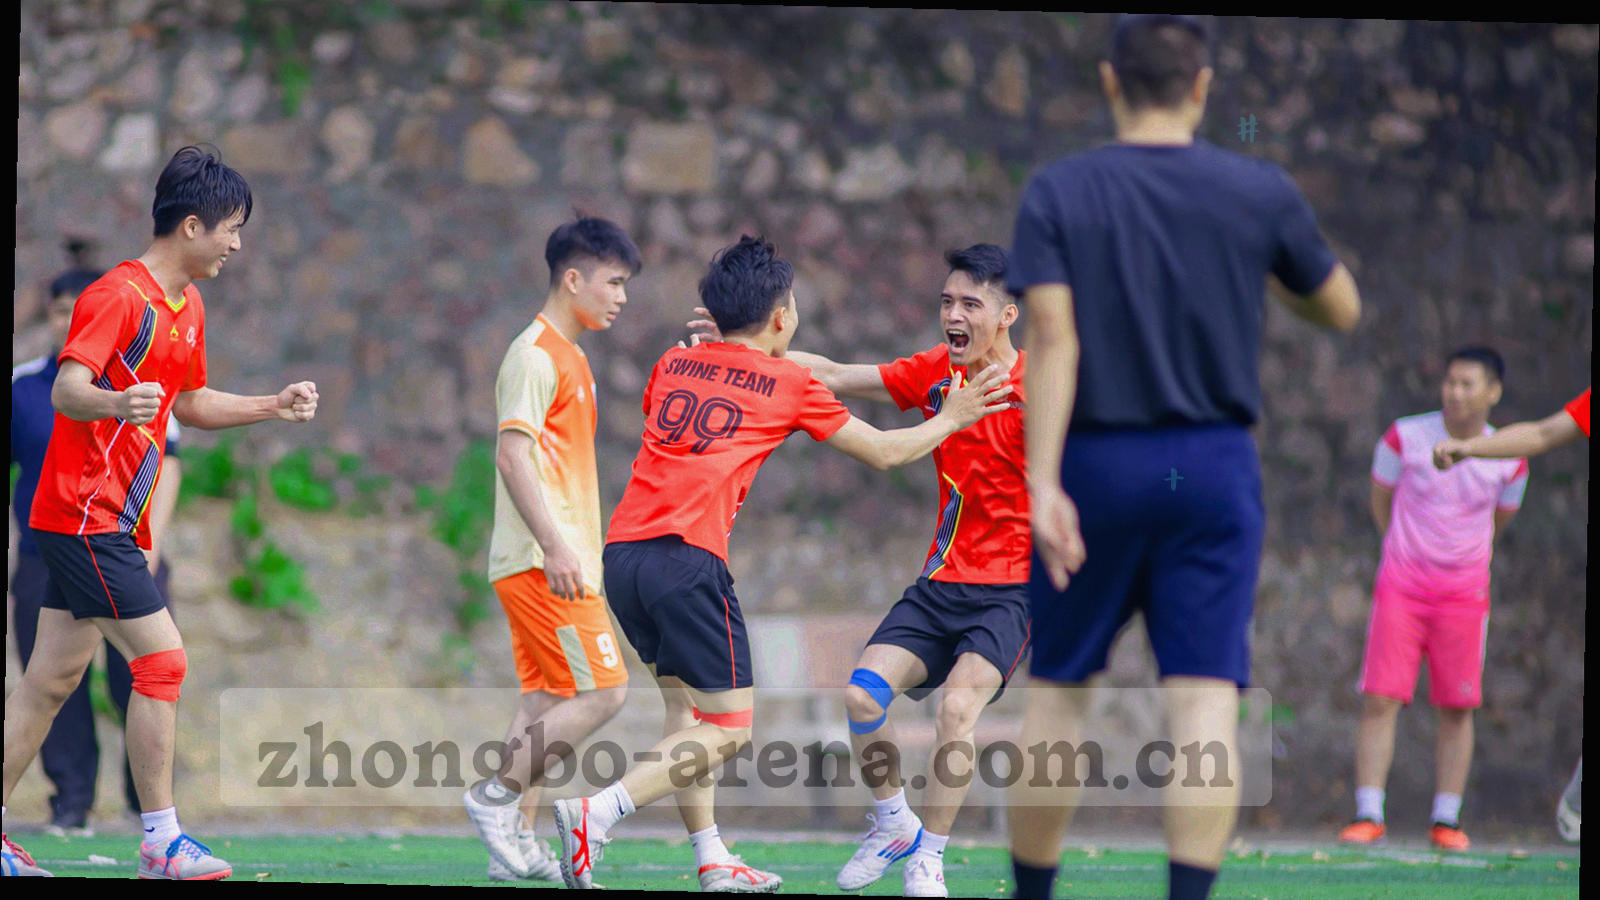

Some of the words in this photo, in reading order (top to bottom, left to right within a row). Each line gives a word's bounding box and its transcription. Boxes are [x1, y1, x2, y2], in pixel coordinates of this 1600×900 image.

[665, 358, 721, 382] SWINE
[723, 367, 777, 397] TEAM
[656, 389, 743, 454] 99
[595, 632, 618, 668] 9
